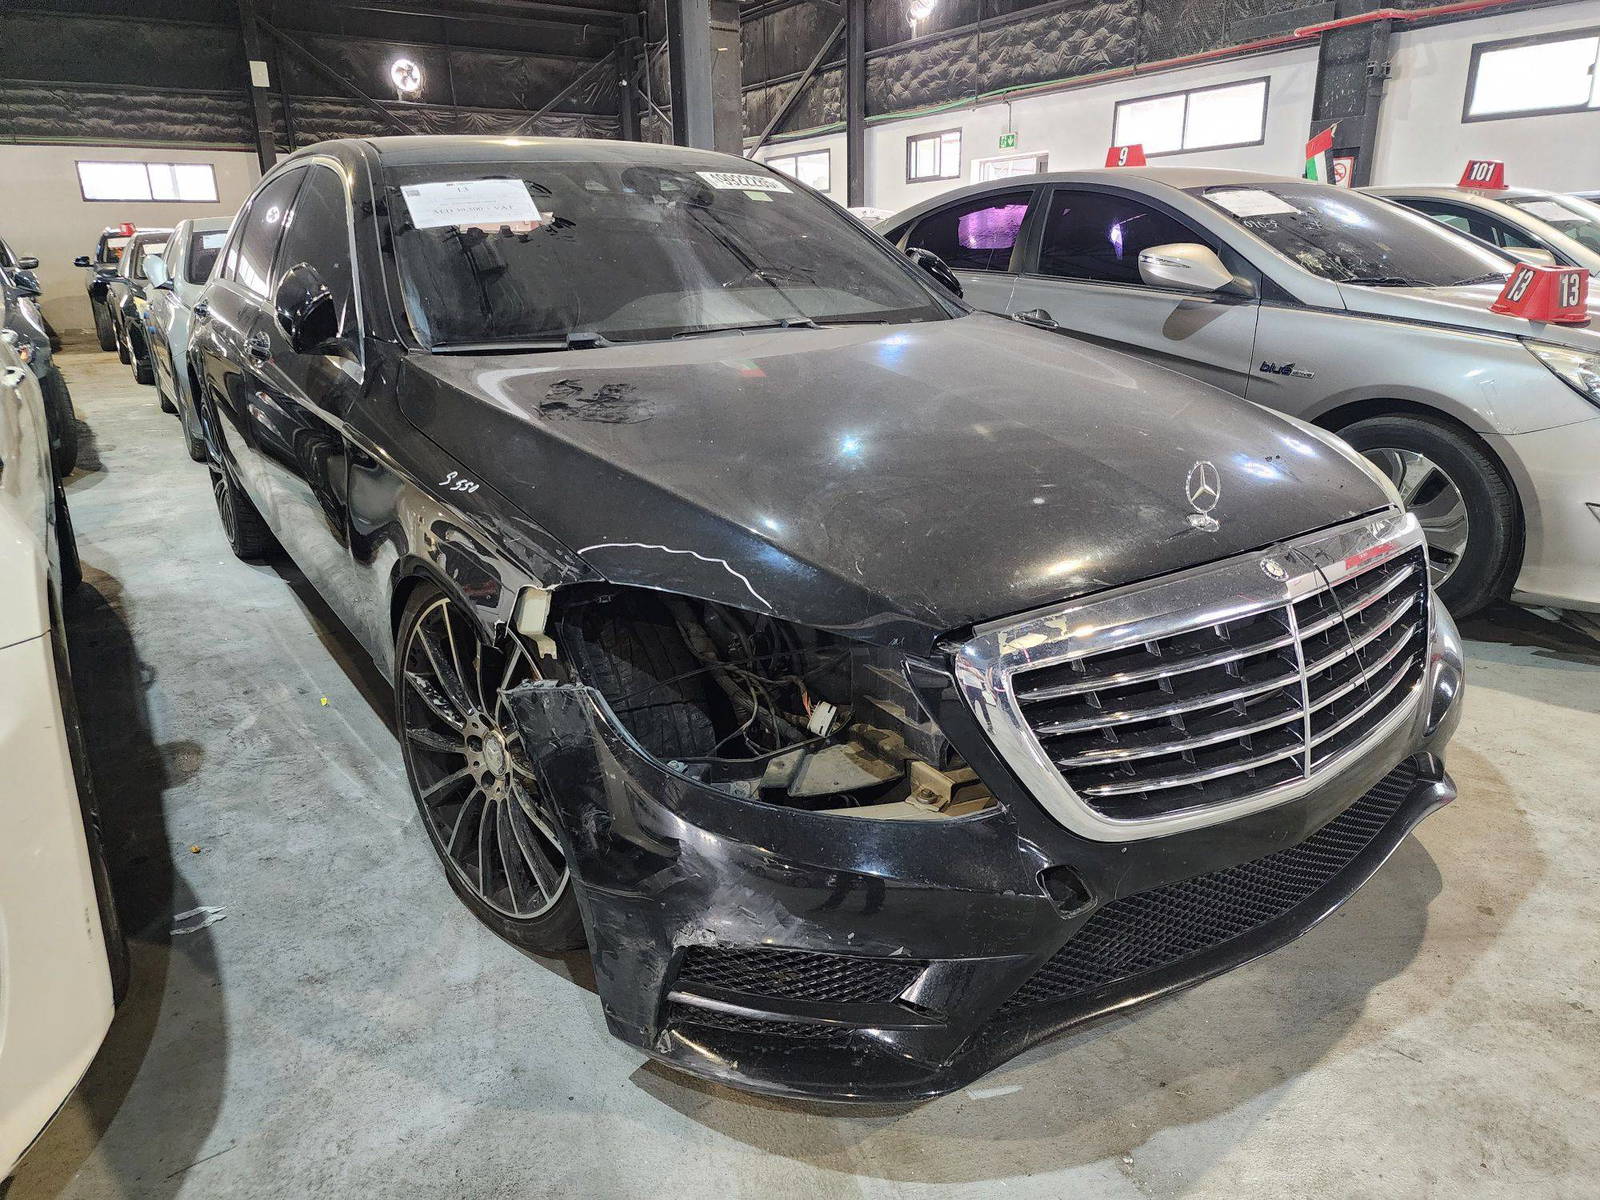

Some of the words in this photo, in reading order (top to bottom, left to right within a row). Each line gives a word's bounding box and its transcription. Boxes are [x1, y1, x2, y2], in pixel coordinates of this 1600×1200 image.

[1118, 146, 1129, 166] 9
[1470, 162, 1496, 182] 101
[1507, 268, 1536, 302] 13
[1561, 273, 1580, 307] 13
